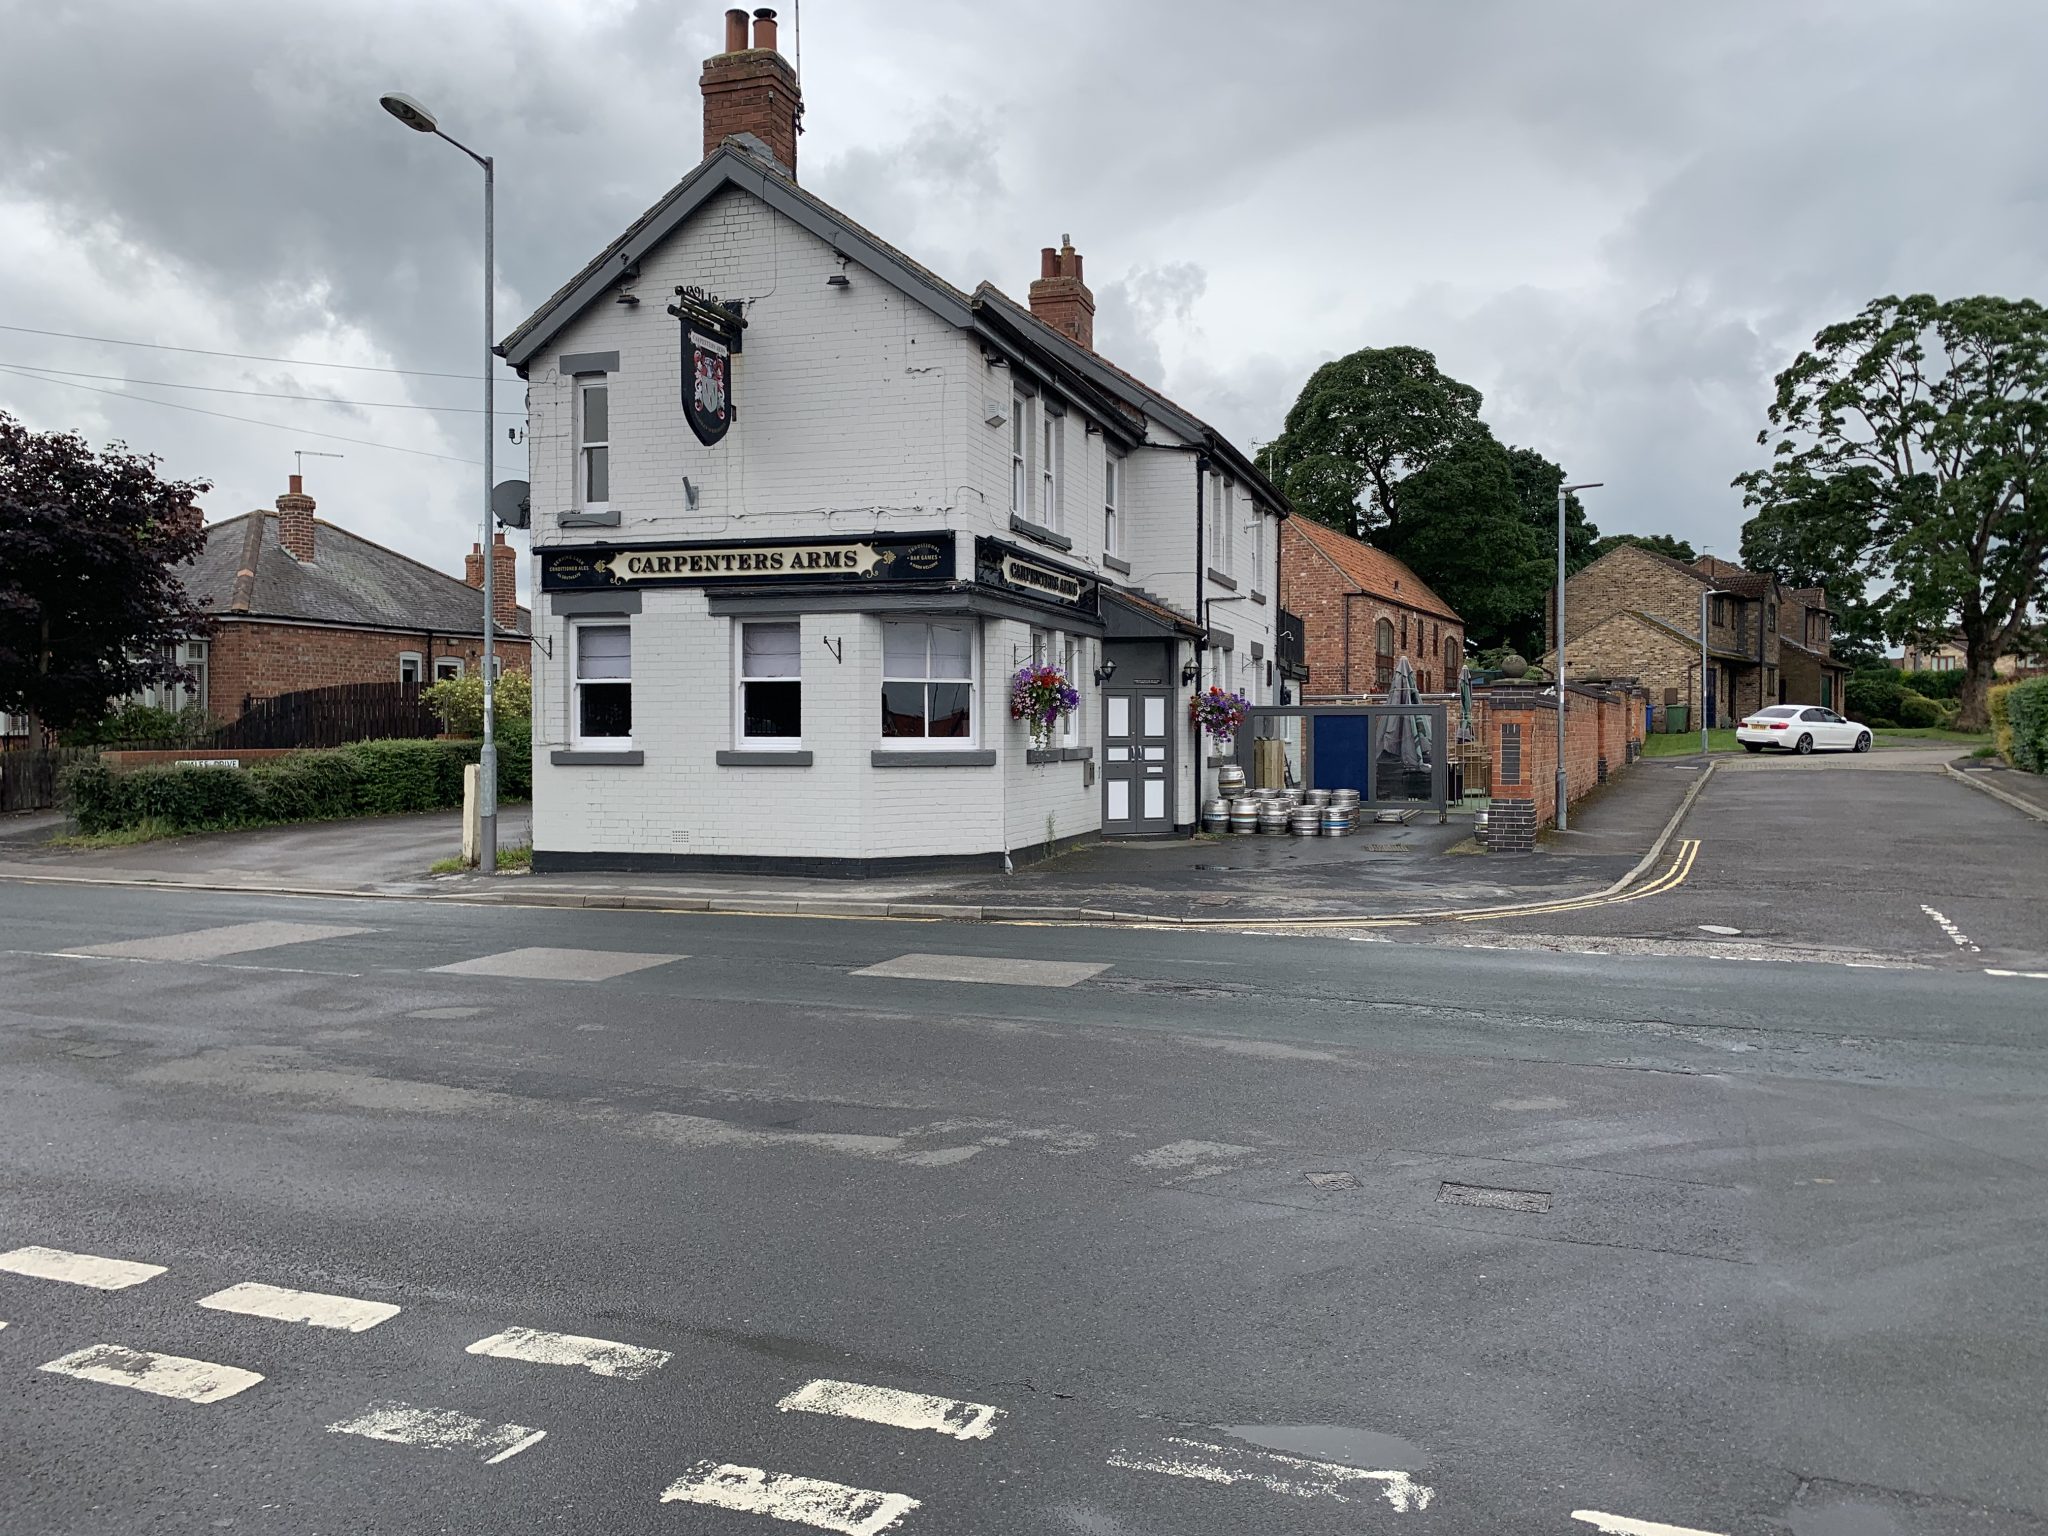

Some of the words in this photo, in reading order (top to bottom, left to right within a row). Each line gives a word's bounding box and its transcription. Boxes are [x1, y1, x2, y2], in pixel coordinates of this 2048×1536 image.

[627, 553, 784, 573] CARPENTERS
[789, 550, 858, 569] ARMS
[1009, 562, 1060, 591] CARPENTERS
[1058, 578, 1078, 597] ARMS
